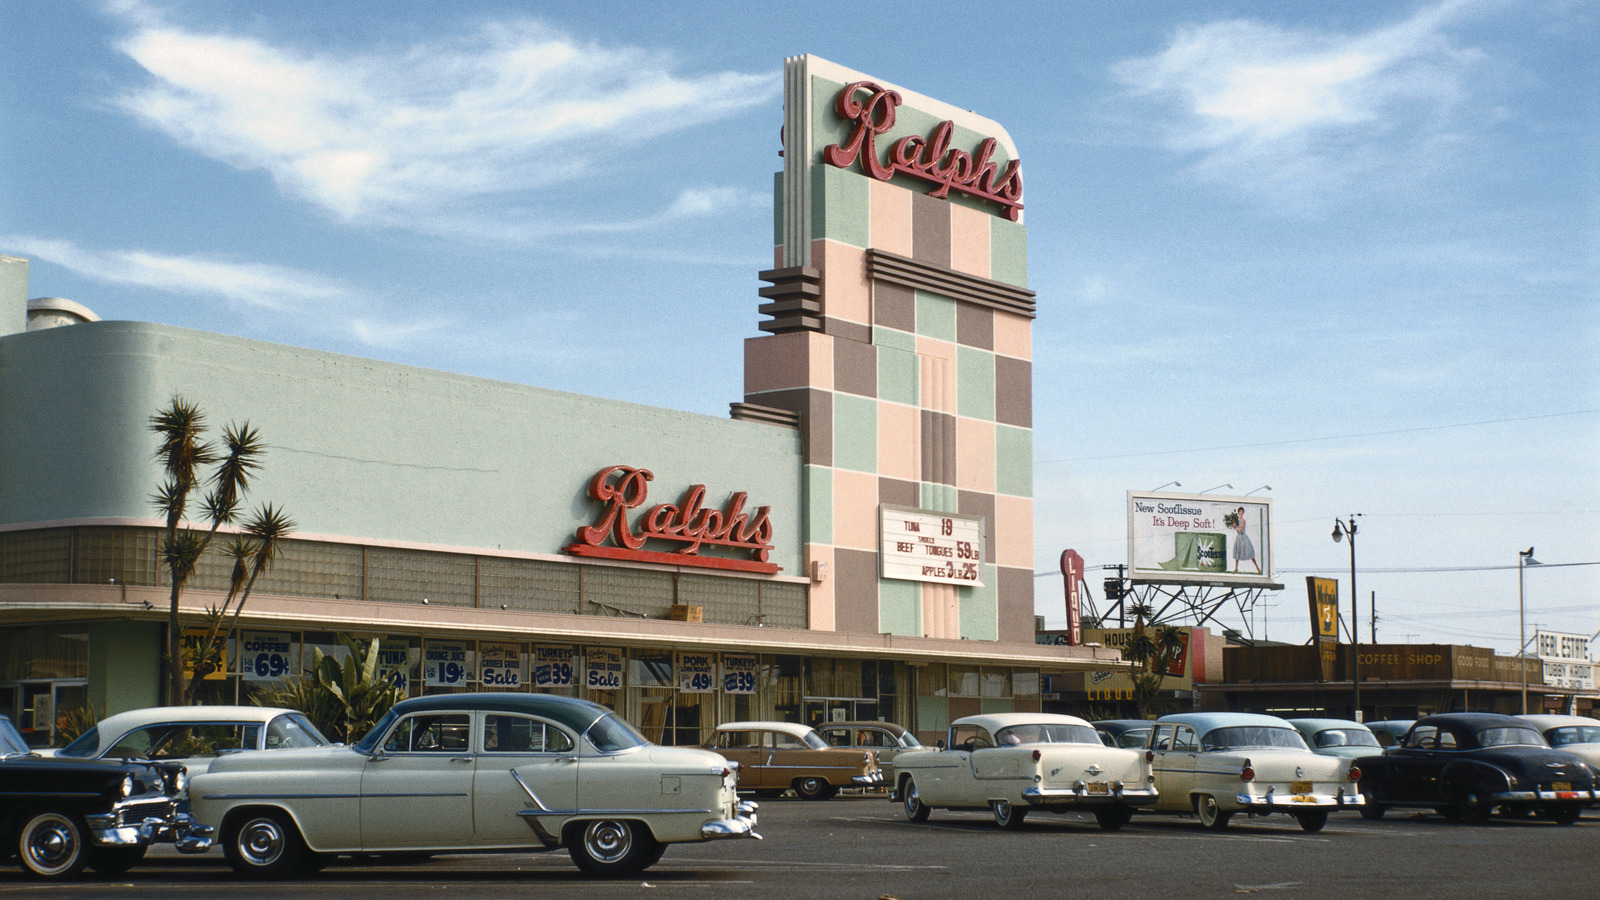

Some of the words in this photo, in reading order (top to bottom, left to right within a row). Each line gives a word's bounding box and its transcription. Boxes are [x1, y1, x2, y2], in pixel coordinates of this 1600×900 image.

[823, 80, 1024, 212] Ralphs
[576, 464, 774, 560] Ralphs
[1135, 502, 1155, 513] New
[904, 520, 920, 533] TUNA
[941, 518, 953, 536] 19
[1152, 516, 1165, 526] It's
[1167, 516, 1190, 530] Deep
[897, 541, 914, 553] BEEF
[925, 545, 953, 558] TONGUES
[957, 541, 972, 559] 59
[922, 566, 946, 578] APPLES
[946, 561, 954, 578] 3
[954, 569, 963, 579] LB
[963, 563, 977, 580] 25
[244, 641, 290, 653] COFFEE
[1105, 632, 1132, 647] HOUS
[1540, 634, 1559, 657] REAL
[1561, 636, 1588, 660] ESTATE
[378, 650, 407, 665] TUNA
[426, 650, 449, 661] ORANGE
[450, 651, 466, 662] JUICE
[537, 648, 573, 659] TURKEYS
[683, 656, 709, 667] PORK
[1357, 654, 1399, 665] COFFEE
[1408, 654, 1442, 664] SHOP
[1457, 655, 1474, 667] GOOD
[254, 653, 289, 677] 69¢
[725, 657, 756, 667] TURKEYS
[438, 662, 464, 684] 19¢
[483, 668, 518, 685] Sale
[588, 670, 619, 687] Sale
[691, 673, 713, 690] 49¢
